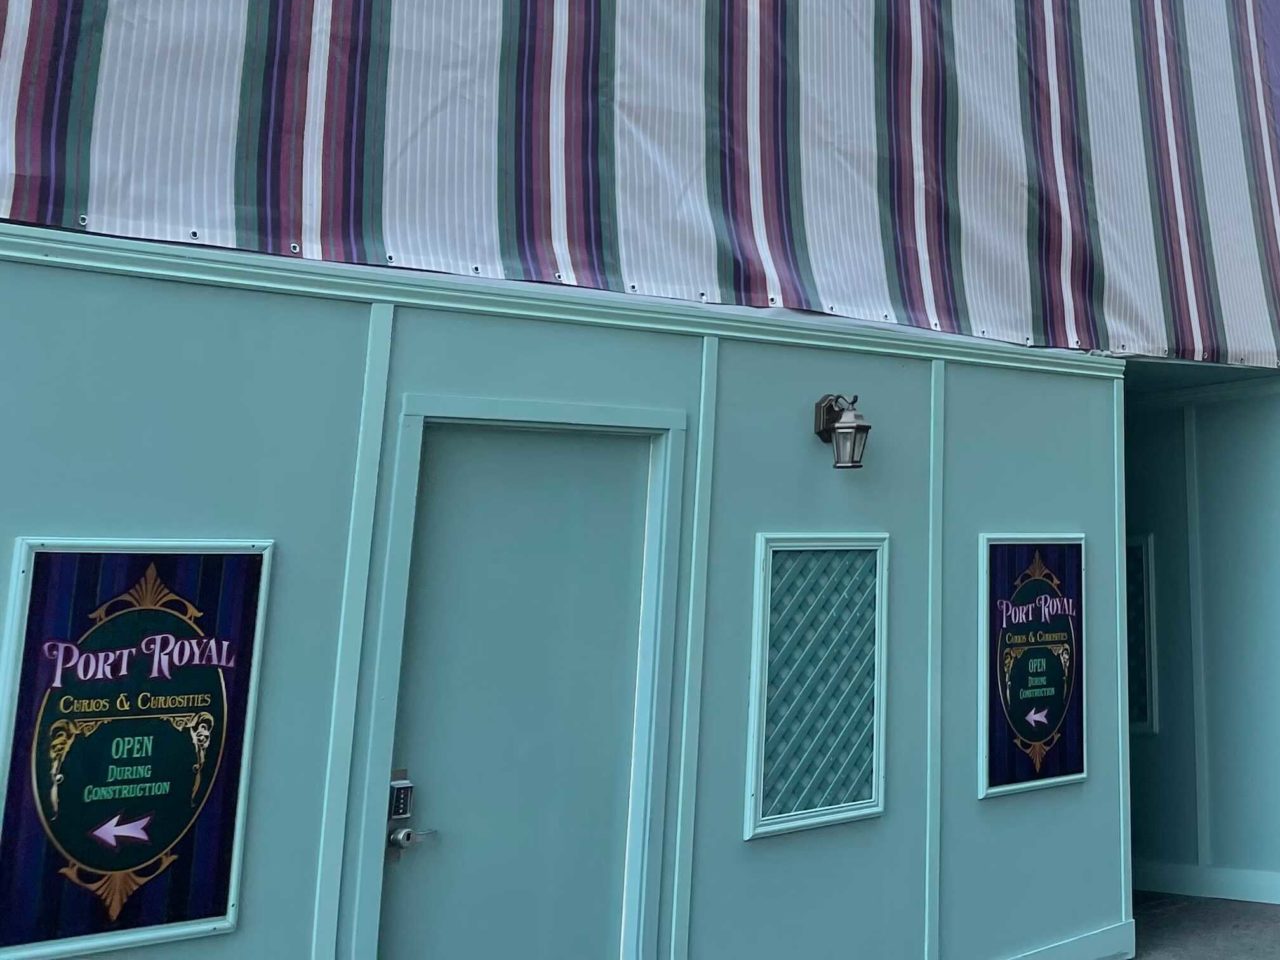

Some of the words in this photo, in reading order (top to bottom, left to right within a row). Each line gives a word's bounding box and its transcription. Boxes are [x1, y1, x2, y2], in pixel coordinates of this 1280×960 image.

[997, 599, 1035, 628] PORT
[1036, 594, 1076, 623] ROYAL
[1028, 631, 1035, 643] &
[43, 641, 136, 689] PORT
[140, 633, 236, 681] ROYAL
[1028, 658, 1046, 673] OPEN
[59, 695, 110, 714] CURIOS
[115, 692, 131, 711] &
[136, 691, 212, 711] CURIOSITIES
[111, 735, 154, 760] OPEN
[107, 764, 152, 783] DURING
[83, 781, 172, 803] CONSTRUCTION
